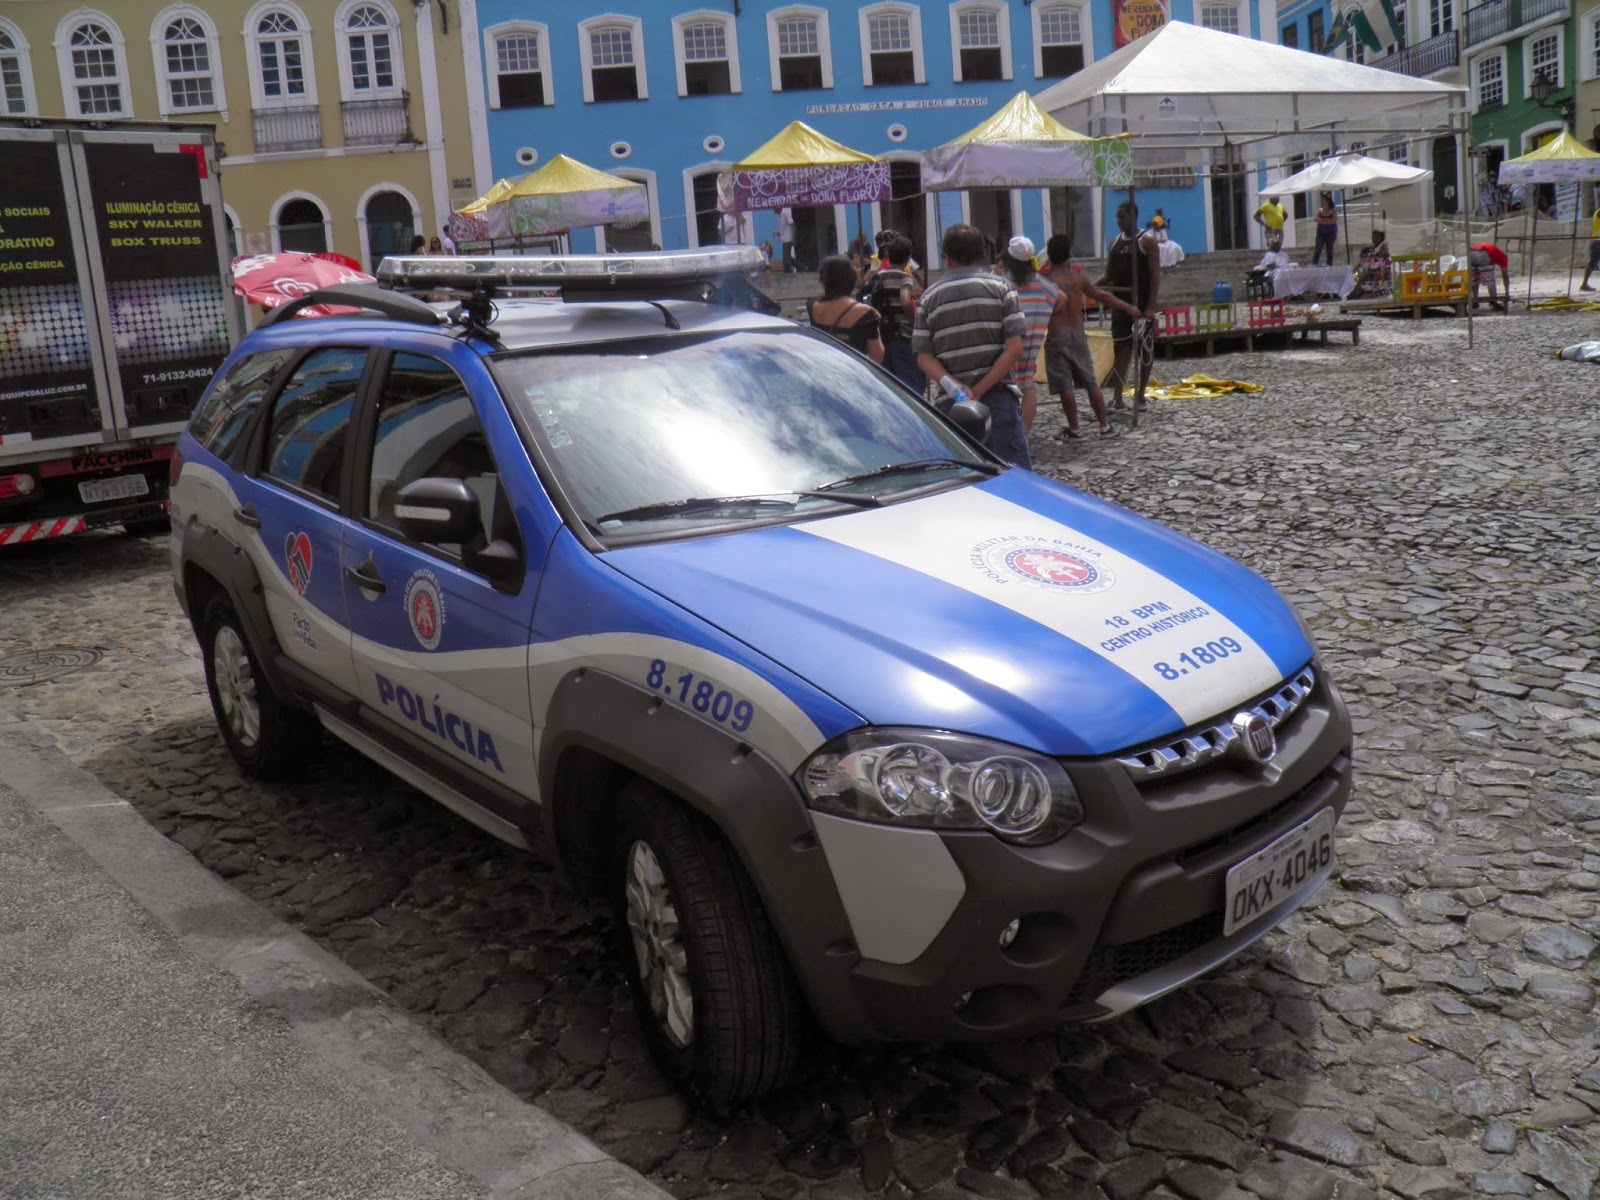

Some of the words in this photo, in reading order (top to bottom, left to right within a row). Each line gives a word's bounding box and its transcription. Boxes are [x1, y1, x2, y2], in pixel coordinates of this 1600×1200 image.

[954, 98, 987, 106] AMADO
[840, 189, 869, 202] FLOR
[4, 206, 51, 217] SOCIAIS
[106, 200, 165, 216] ILUMINAÇÃO
[166, 200, 201, 214] CÊNICA
[108, 220, 139, 229] SKY
[143, 219, 202, 228] WALKER
[111, 237, 145, 247] BOX
[149, 236, 202, 245] TRUSS
[26, 259, 65, 270] CÊNICA
[143, 367, 214, 384] 71-9132-0424
[1024, 535, 1048, 543] DA
[1053, 539, 1103, 558] BAHIA
[1105, 615, 1130, 629] 18
[1131, 600, 1173, 619] BPM
[1100, 627, 1153, 652] CENTRO
[1148, 606, 1210, 633] HISTÓRICO
[1153, 636, 1243, 681] 8.1809
[646, 659, 754, 733] 8.1809
[375, 672, 505, 774] POLÍCIA
